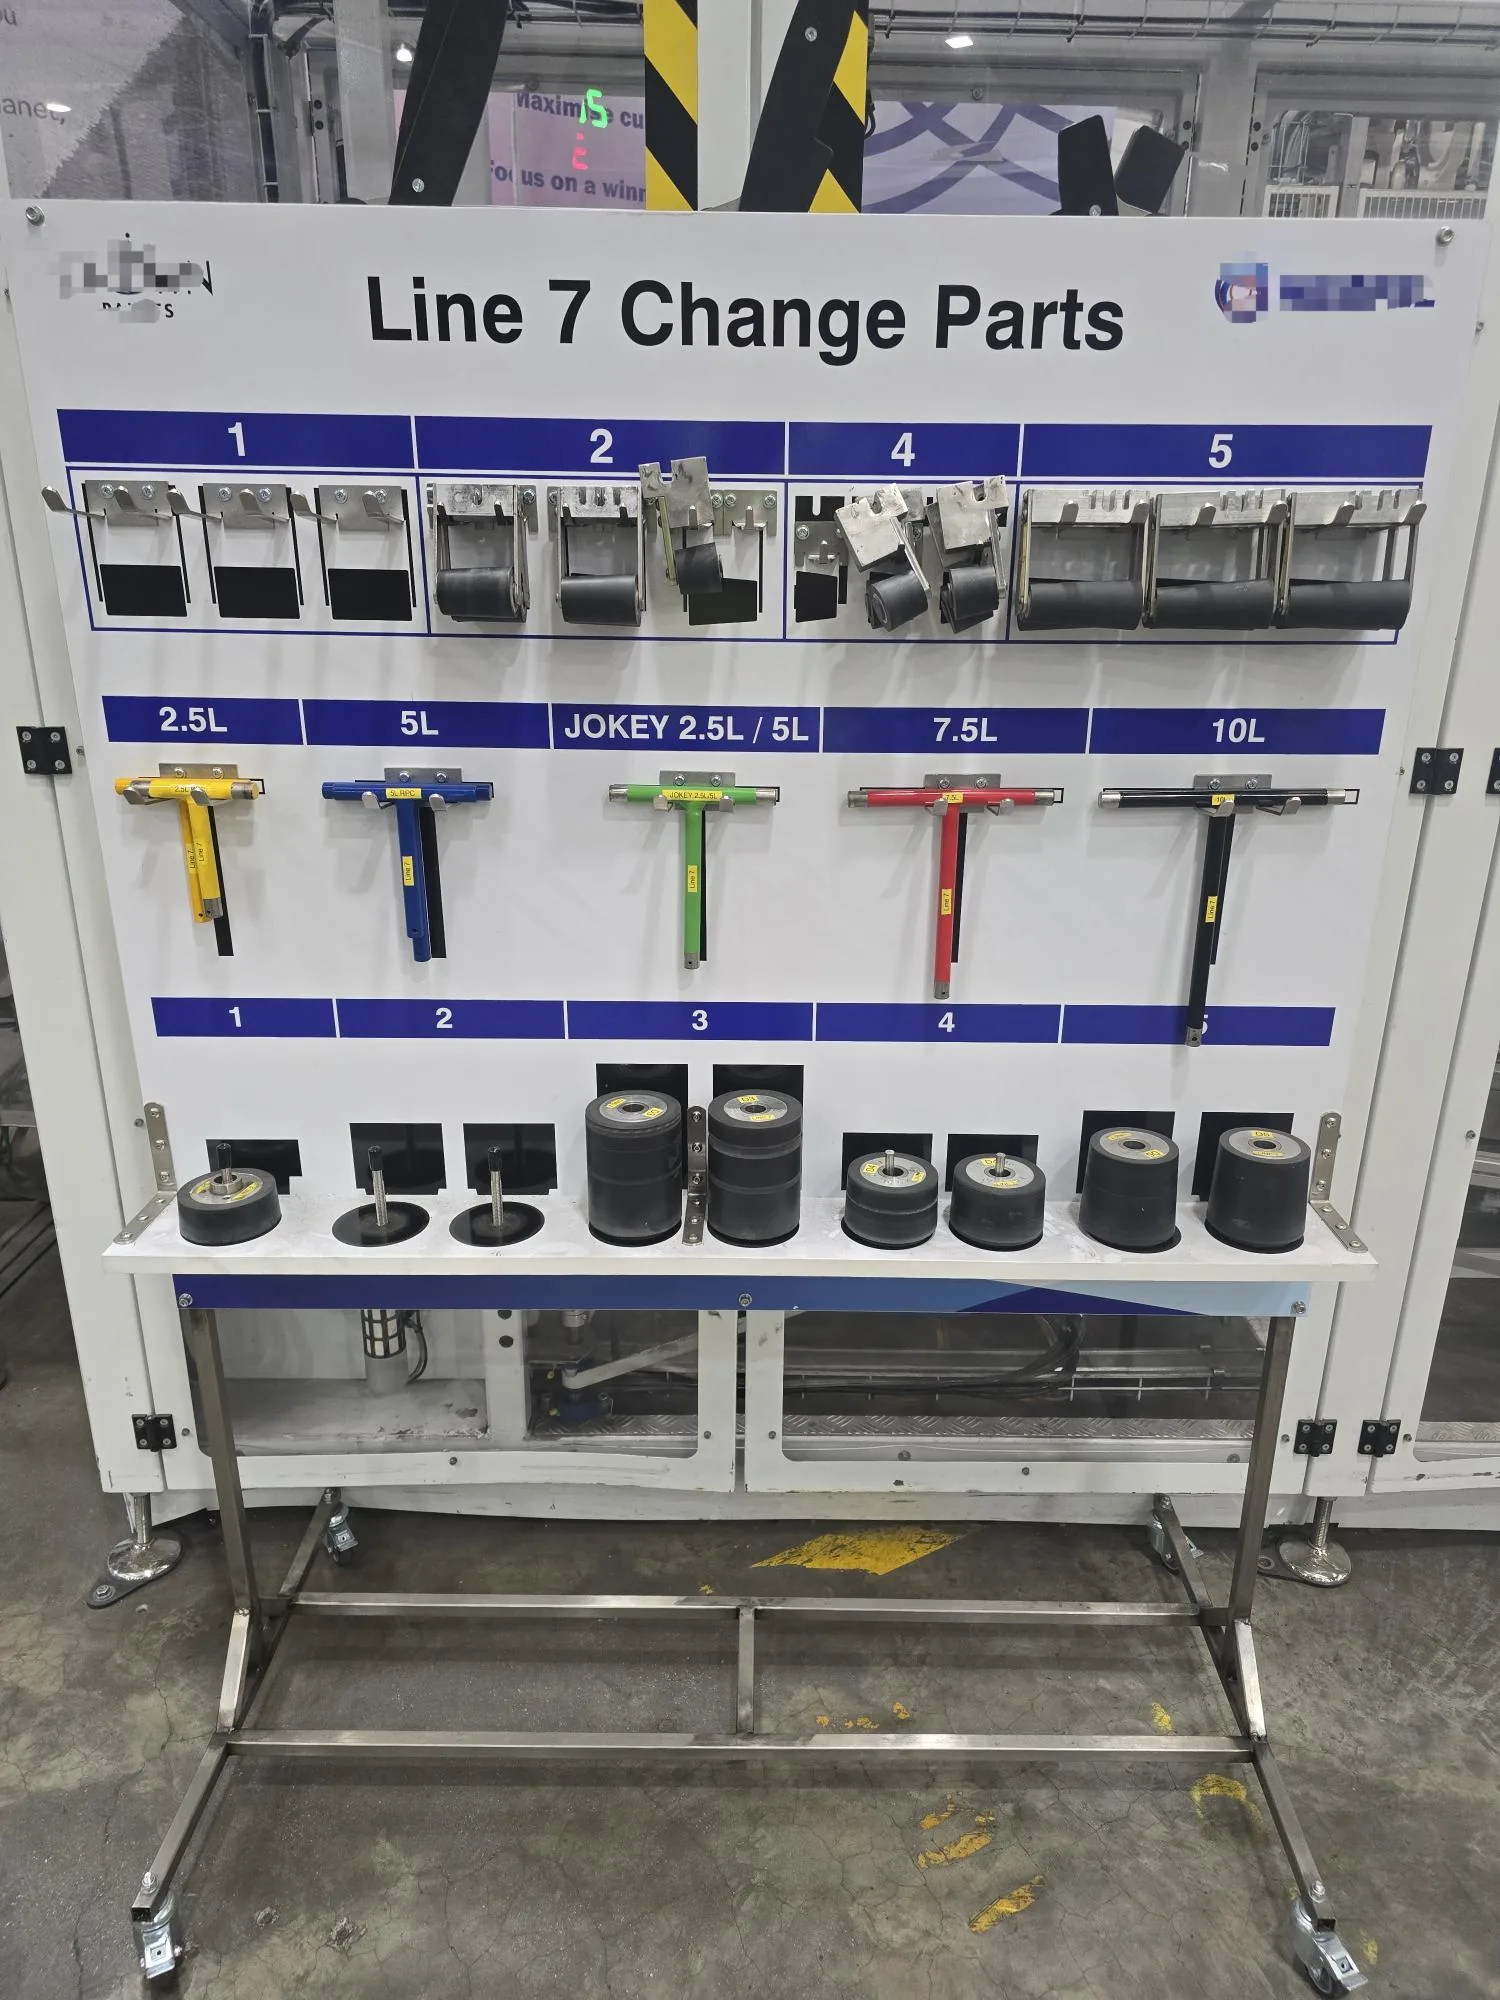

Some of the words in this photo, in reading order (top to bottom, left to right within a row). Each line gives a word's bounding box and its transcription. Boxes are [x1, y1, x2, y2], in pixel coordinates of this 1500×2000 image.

[551, 174, 577, 192] on
[584, 179, 596, 195] a
[367, 276, 523, 344] Line
[548, 279, 591, 344] 7
[621, 279, 906, 367] Change
[935, 284, 1124, 351] Parts
[228, 422, 245, 457] 1
[589, 429, 614, 464] 2
[891, 433, 916, 467] 4
[1208, 433, 1234, 469] 5
[159, 707, 228, 733] 2.5L
[400, 711, 439, 736] 5L
[564, 713, 669, 740] JOKEY
[678, 715, 744, 741] 2.5L
[752, 717, 762, 744] /
[772, 716, 809, 742] 5L
[933, 717, 998, 743] 7.5L
[1212, 718, 1265, 743] 10L
[669, 791, 692, 799] JOKEY
[228, 1006, 242, 1028] 1
[435, 1008, 453, 1029] 2
[691, 1010, 709, 1031] 3
[937, 1012, 956, 1033] 4
